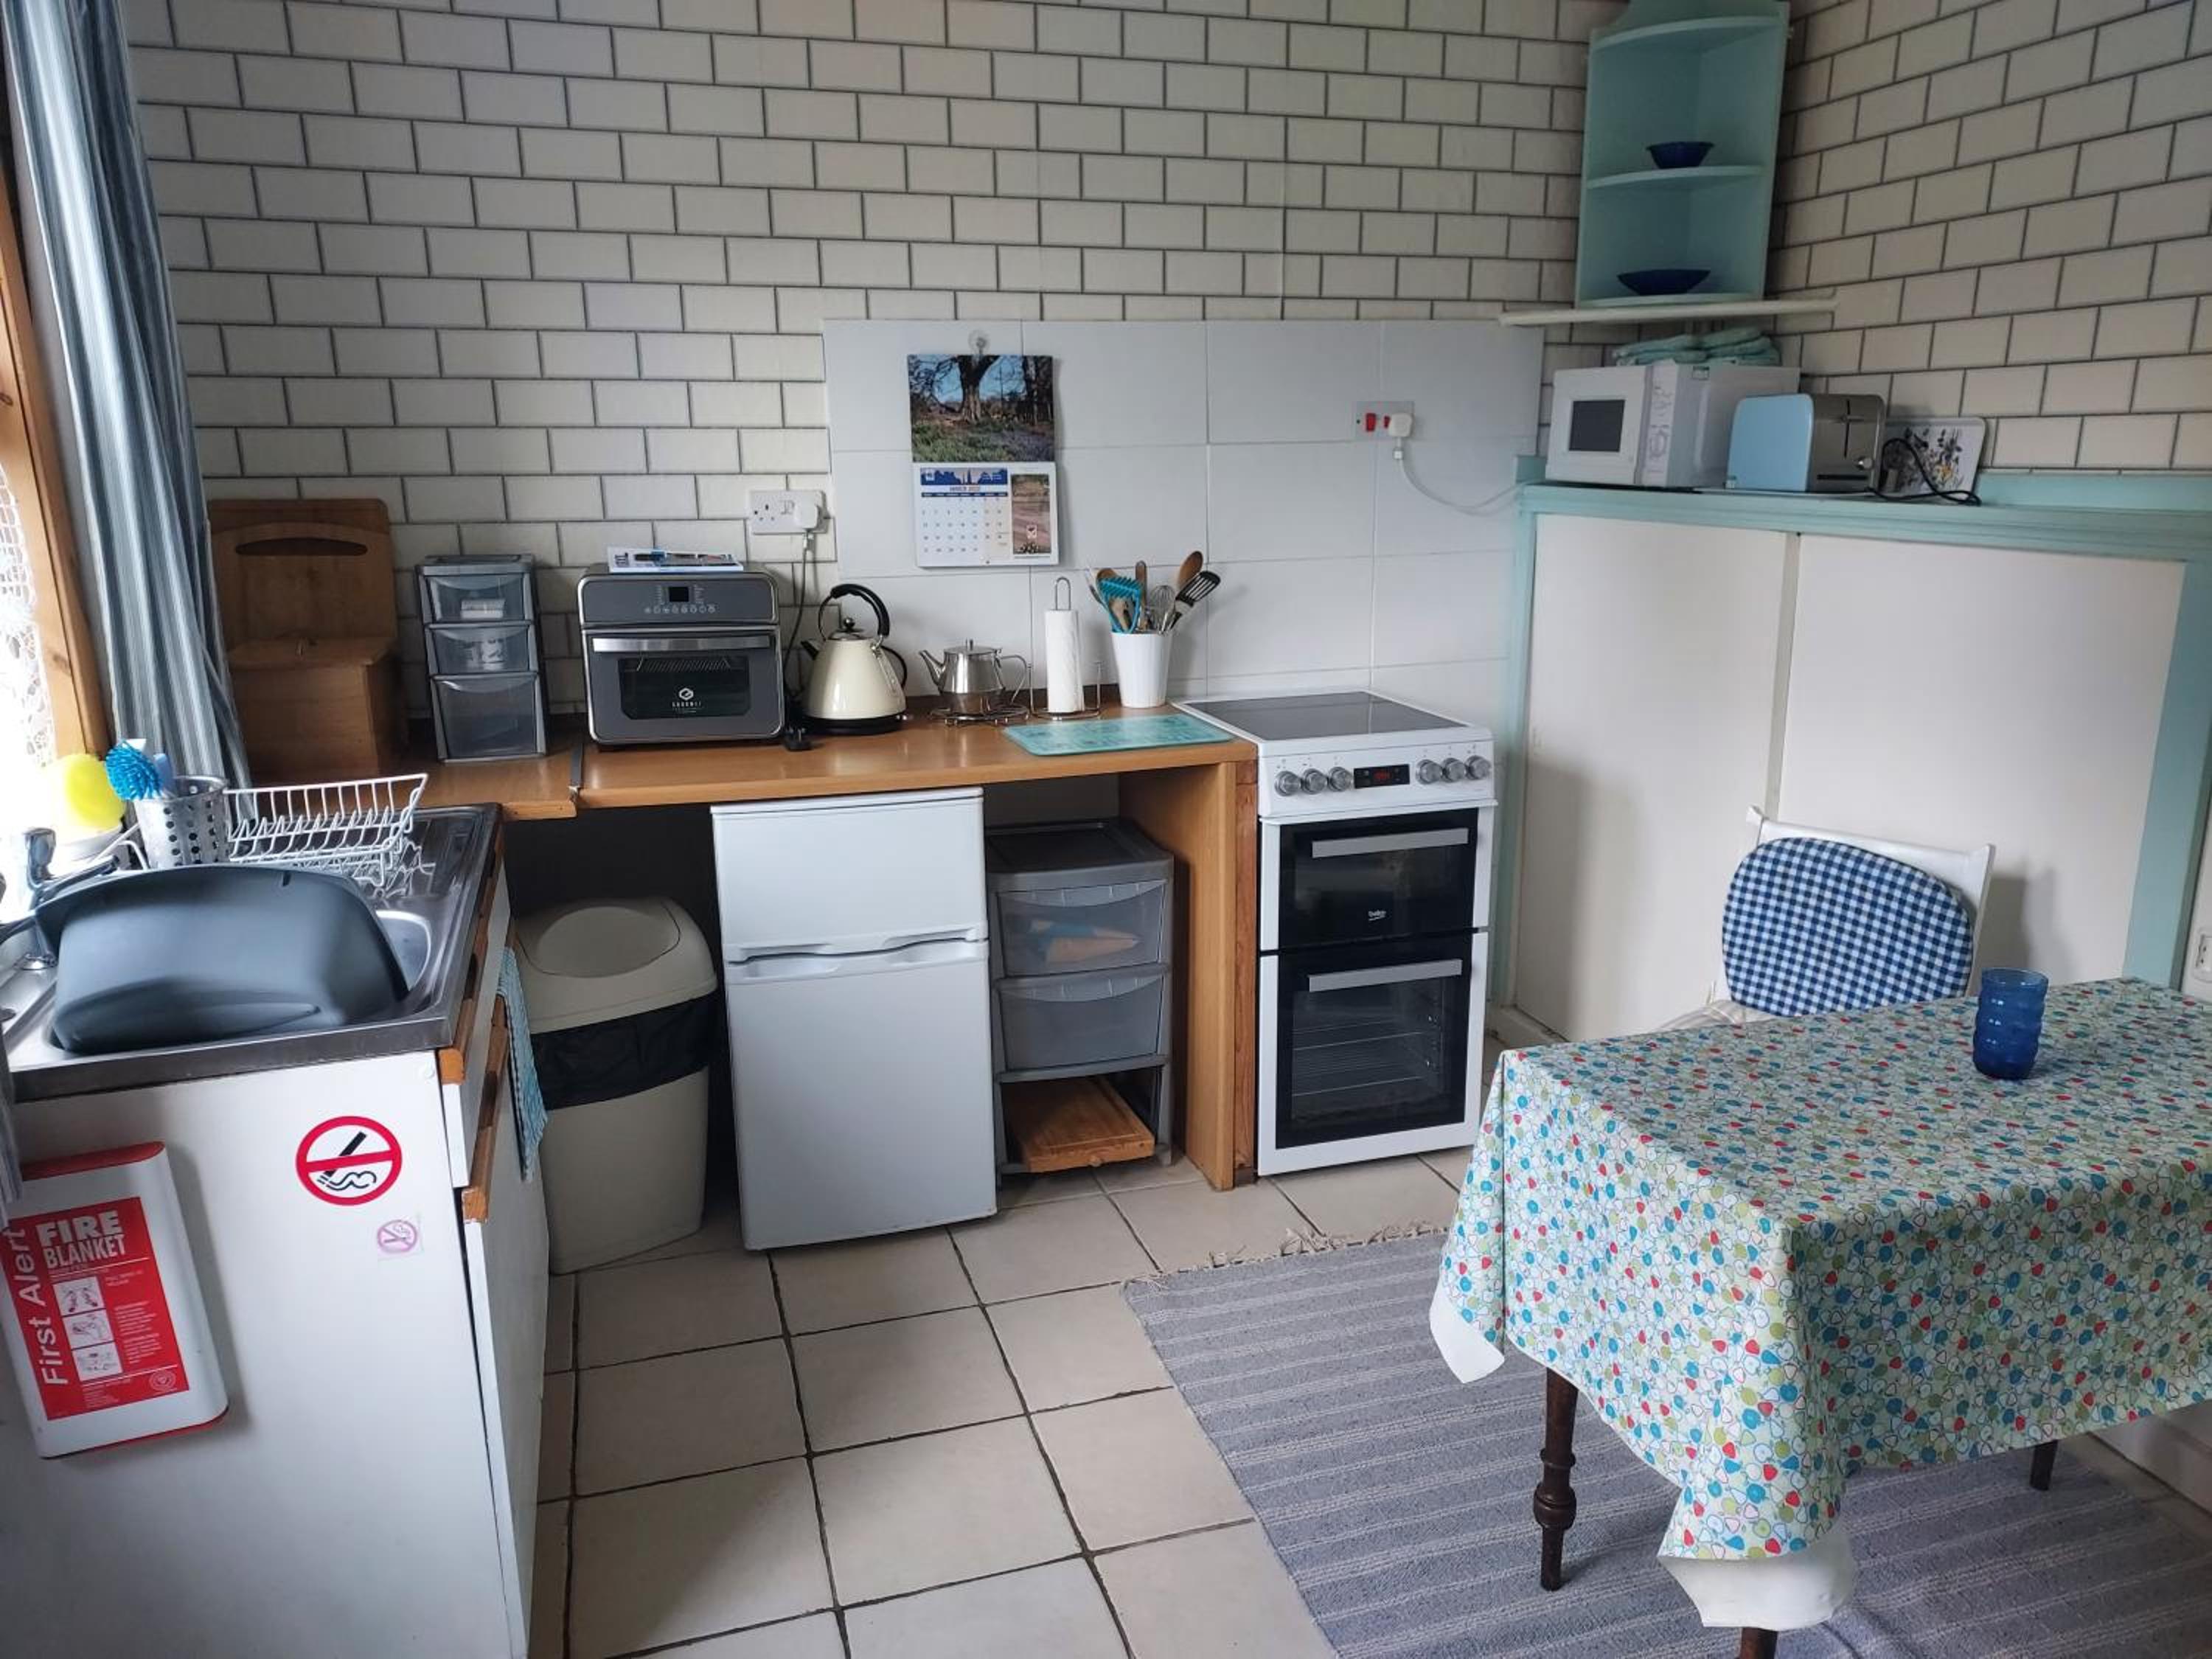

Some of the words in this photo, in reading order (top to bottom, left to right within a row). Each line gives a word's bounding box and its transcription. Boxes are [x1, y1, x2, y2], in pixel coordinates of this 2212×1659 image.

[35, 1210, 122, 1247] FIRE
[43, 1234, 125, 1269] BLANKET
[2, 1228, 46, 1307] Alert
[28, 1316, 69, 1385] First
